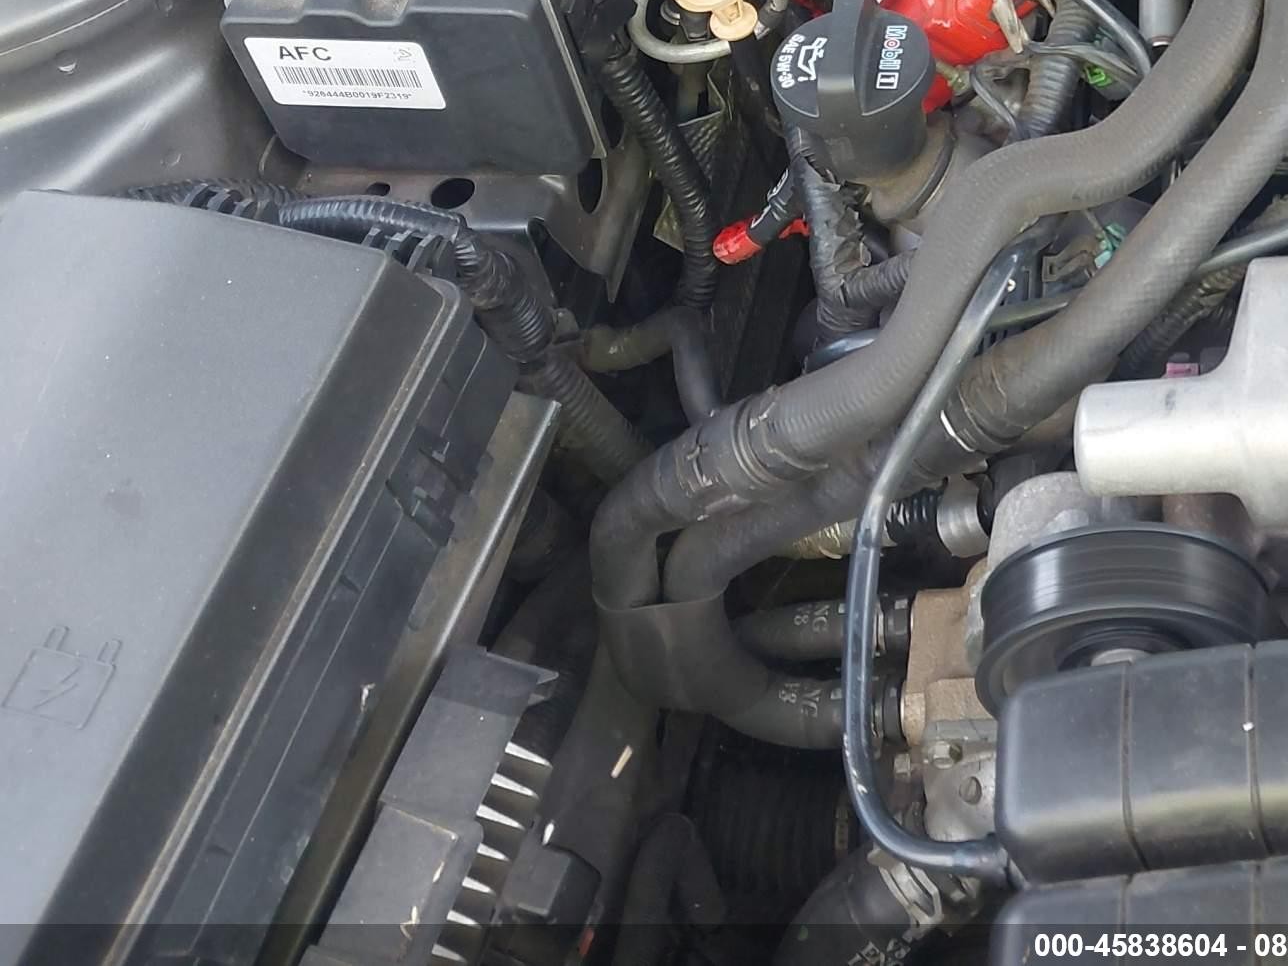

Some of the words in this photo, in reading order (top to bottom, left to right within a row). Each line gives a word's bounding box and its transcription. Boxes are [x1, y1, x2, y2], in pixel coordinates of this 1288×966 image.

[278, 45, 332, 61] AFC
[781, 34, 805, 53] SAE
[879, 26, 907, 70] Mobil
[776, 54, 796, 89] 5W-30
[876, 73, 898, 89] 1
